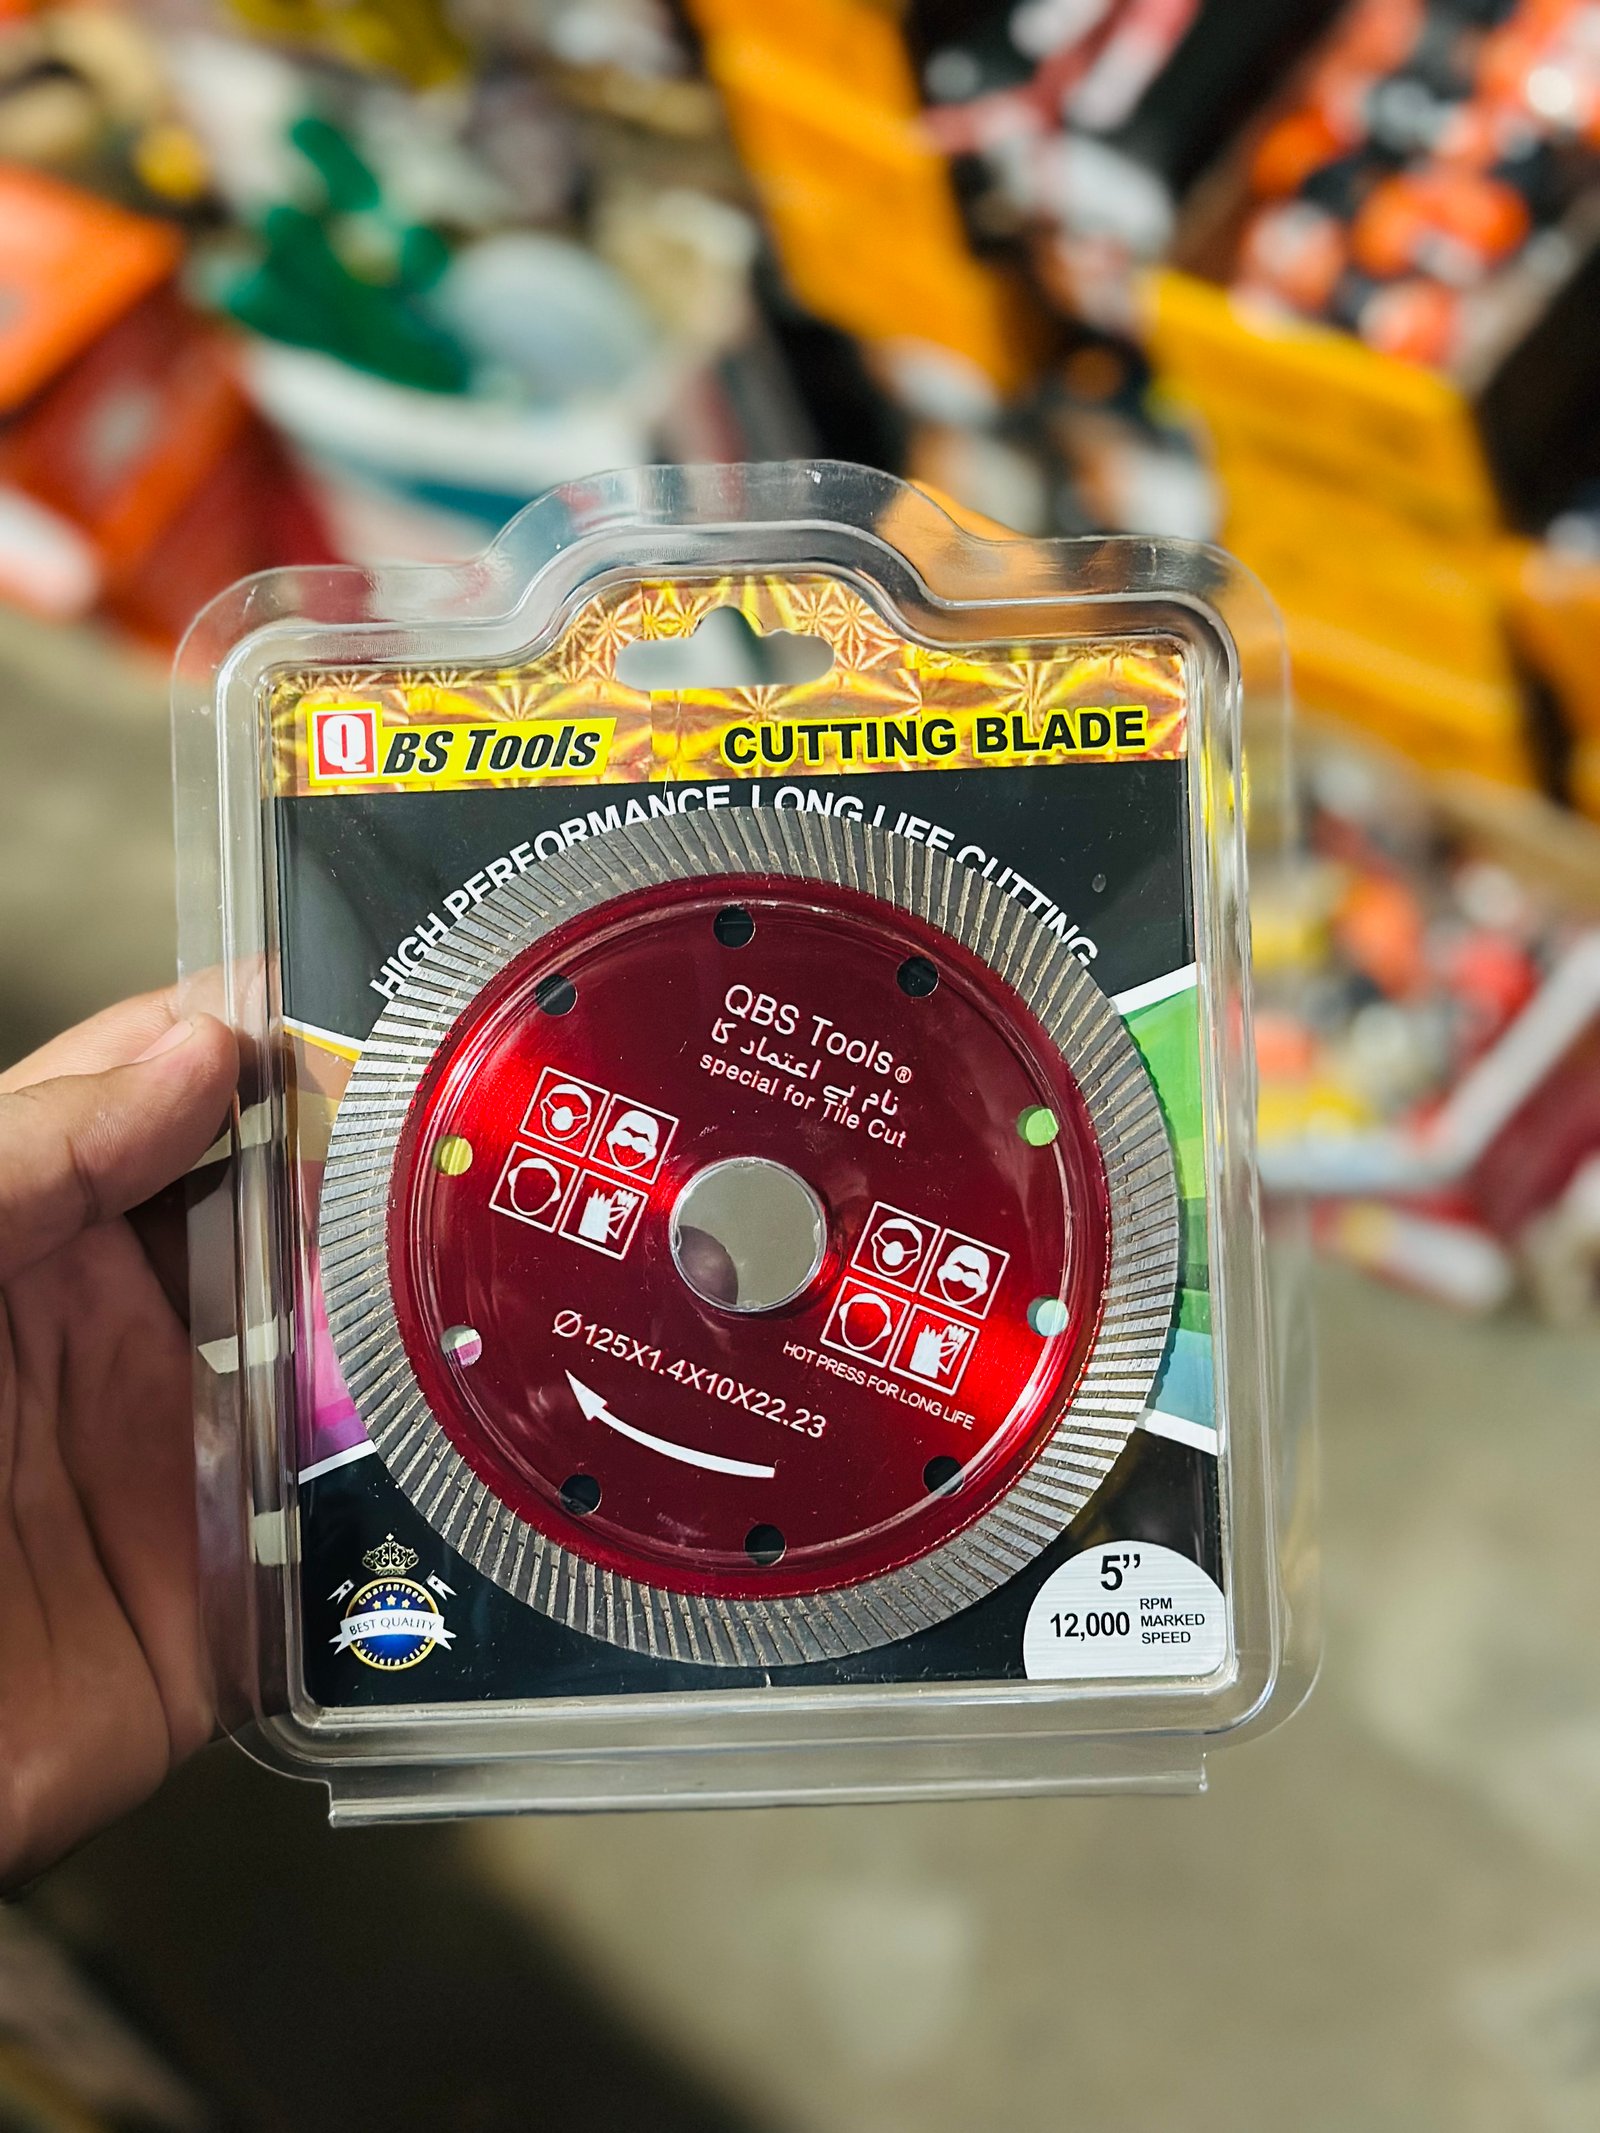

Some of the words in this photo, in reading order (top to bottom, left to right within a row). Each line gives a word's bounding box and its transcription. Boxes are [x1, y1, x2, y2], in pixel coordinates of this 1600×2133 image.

[464, 725, 601, 771] Tools
[724, 718, 957, 764] CUTTING
[976, 710, 1147, 754] BLADE
[369, 912, 450, 1000] HIGH
[442, 785, 731, 920] PERFORMANCE
[724, 984, 800, 1035] QBS
[739, 1036, 821, 1080] اعتماد
[700, 1053, 779, 1096] special
[783, 1084, 816, 1110] for
[822, 1098, 860, 1130] Tile
[867, 1118, 907, 1148] Cut
[861, 1088, 899, 1116] نام
[782, 1340, 817, 1364] HOT
[815, 1353, 867, 1386] PRESS
[866, 1376, 900, 1401] FOR
[899, 1388, 942, 1418] LONG
[944, 1407, 977, 1431] LIFE
[1139, 1597, 1173, 1610] RPM
[1140, 1613, 1206, 1627] MARKED
[349, 1618, 377, 1636] BEST
[381, 1616, 436, 1632] QUALITY
[1050, 1611, 1131, 1641] 12,000
[1141, 1631, 1192, 1645] SPEED
